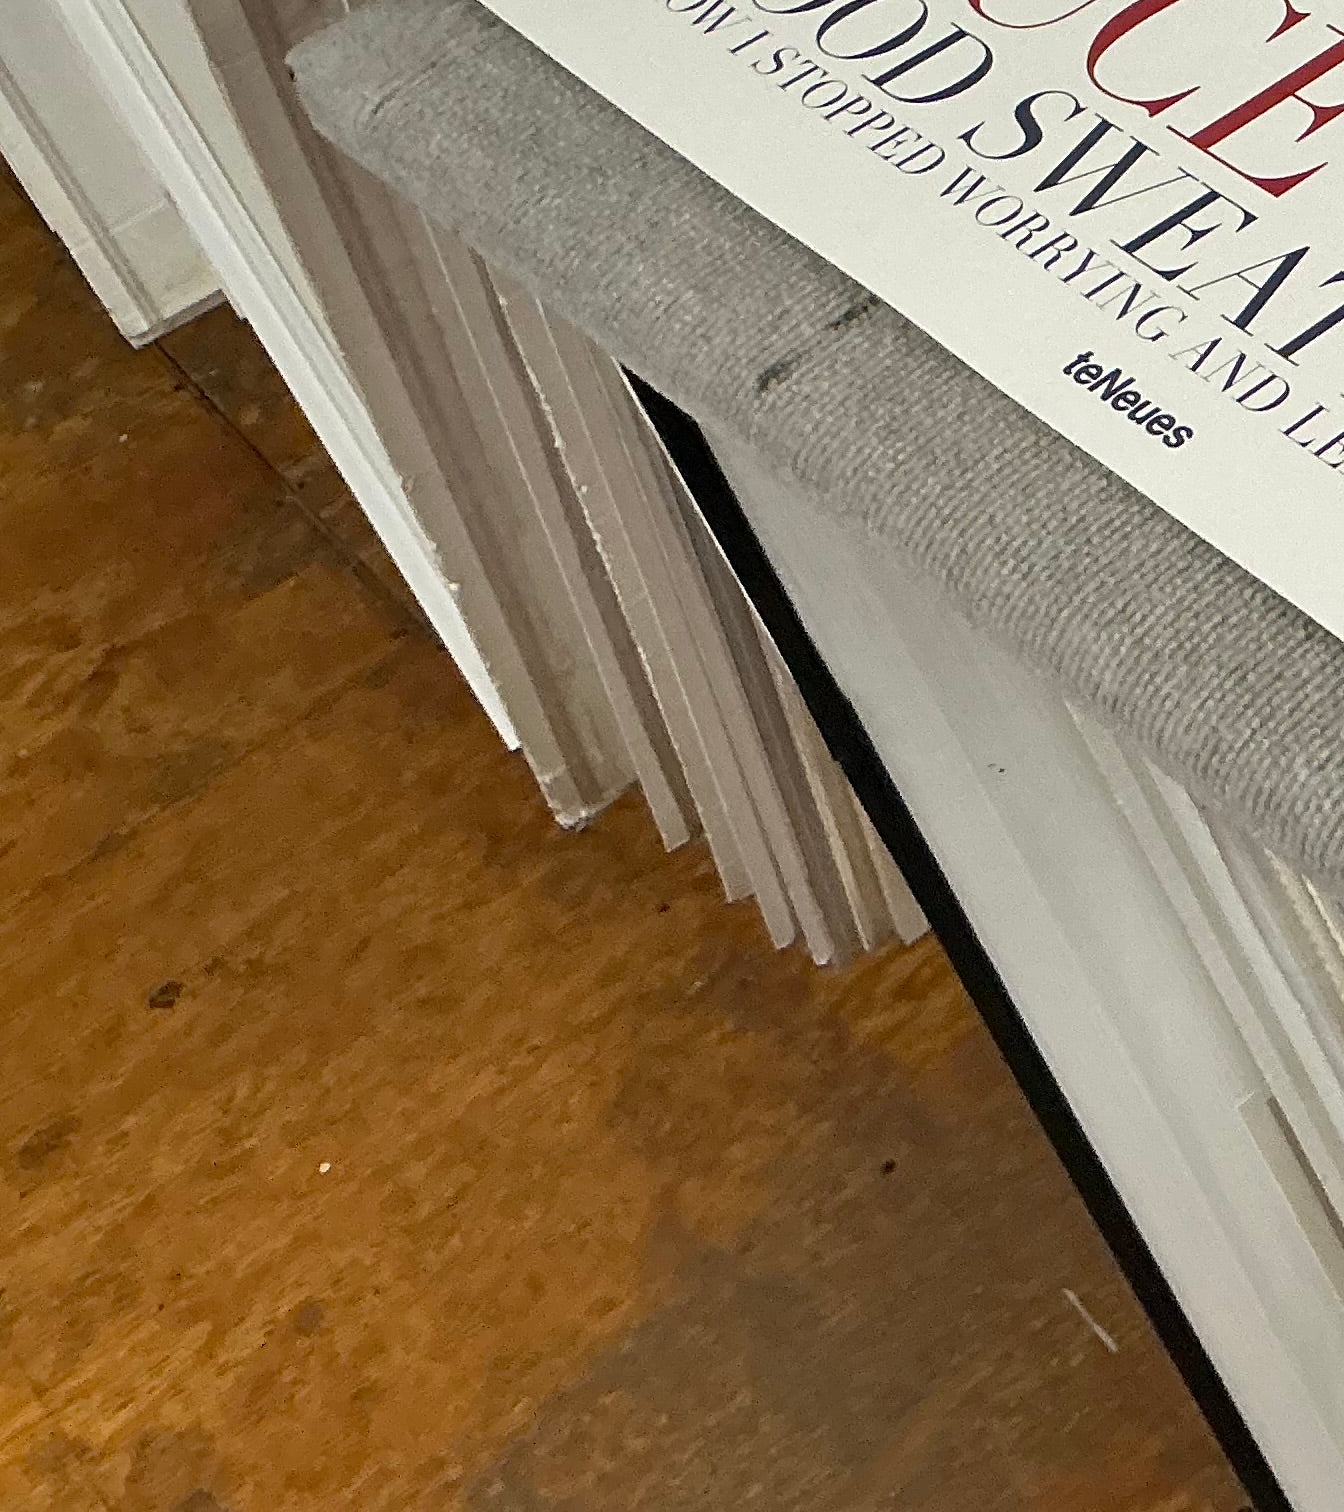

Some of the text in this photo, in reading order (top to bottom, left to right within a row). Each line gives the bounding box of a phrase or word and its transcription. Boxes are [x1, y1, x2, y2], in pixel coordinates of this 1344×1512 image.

[731, 30, 771, 57] I
[747, 46, 946, 175] STOPPED
[939, 164, 1189, 342] WORRYING
[1061, 350, 1194, 448] teNeues
[1167, 337, 1291, 412] AND
